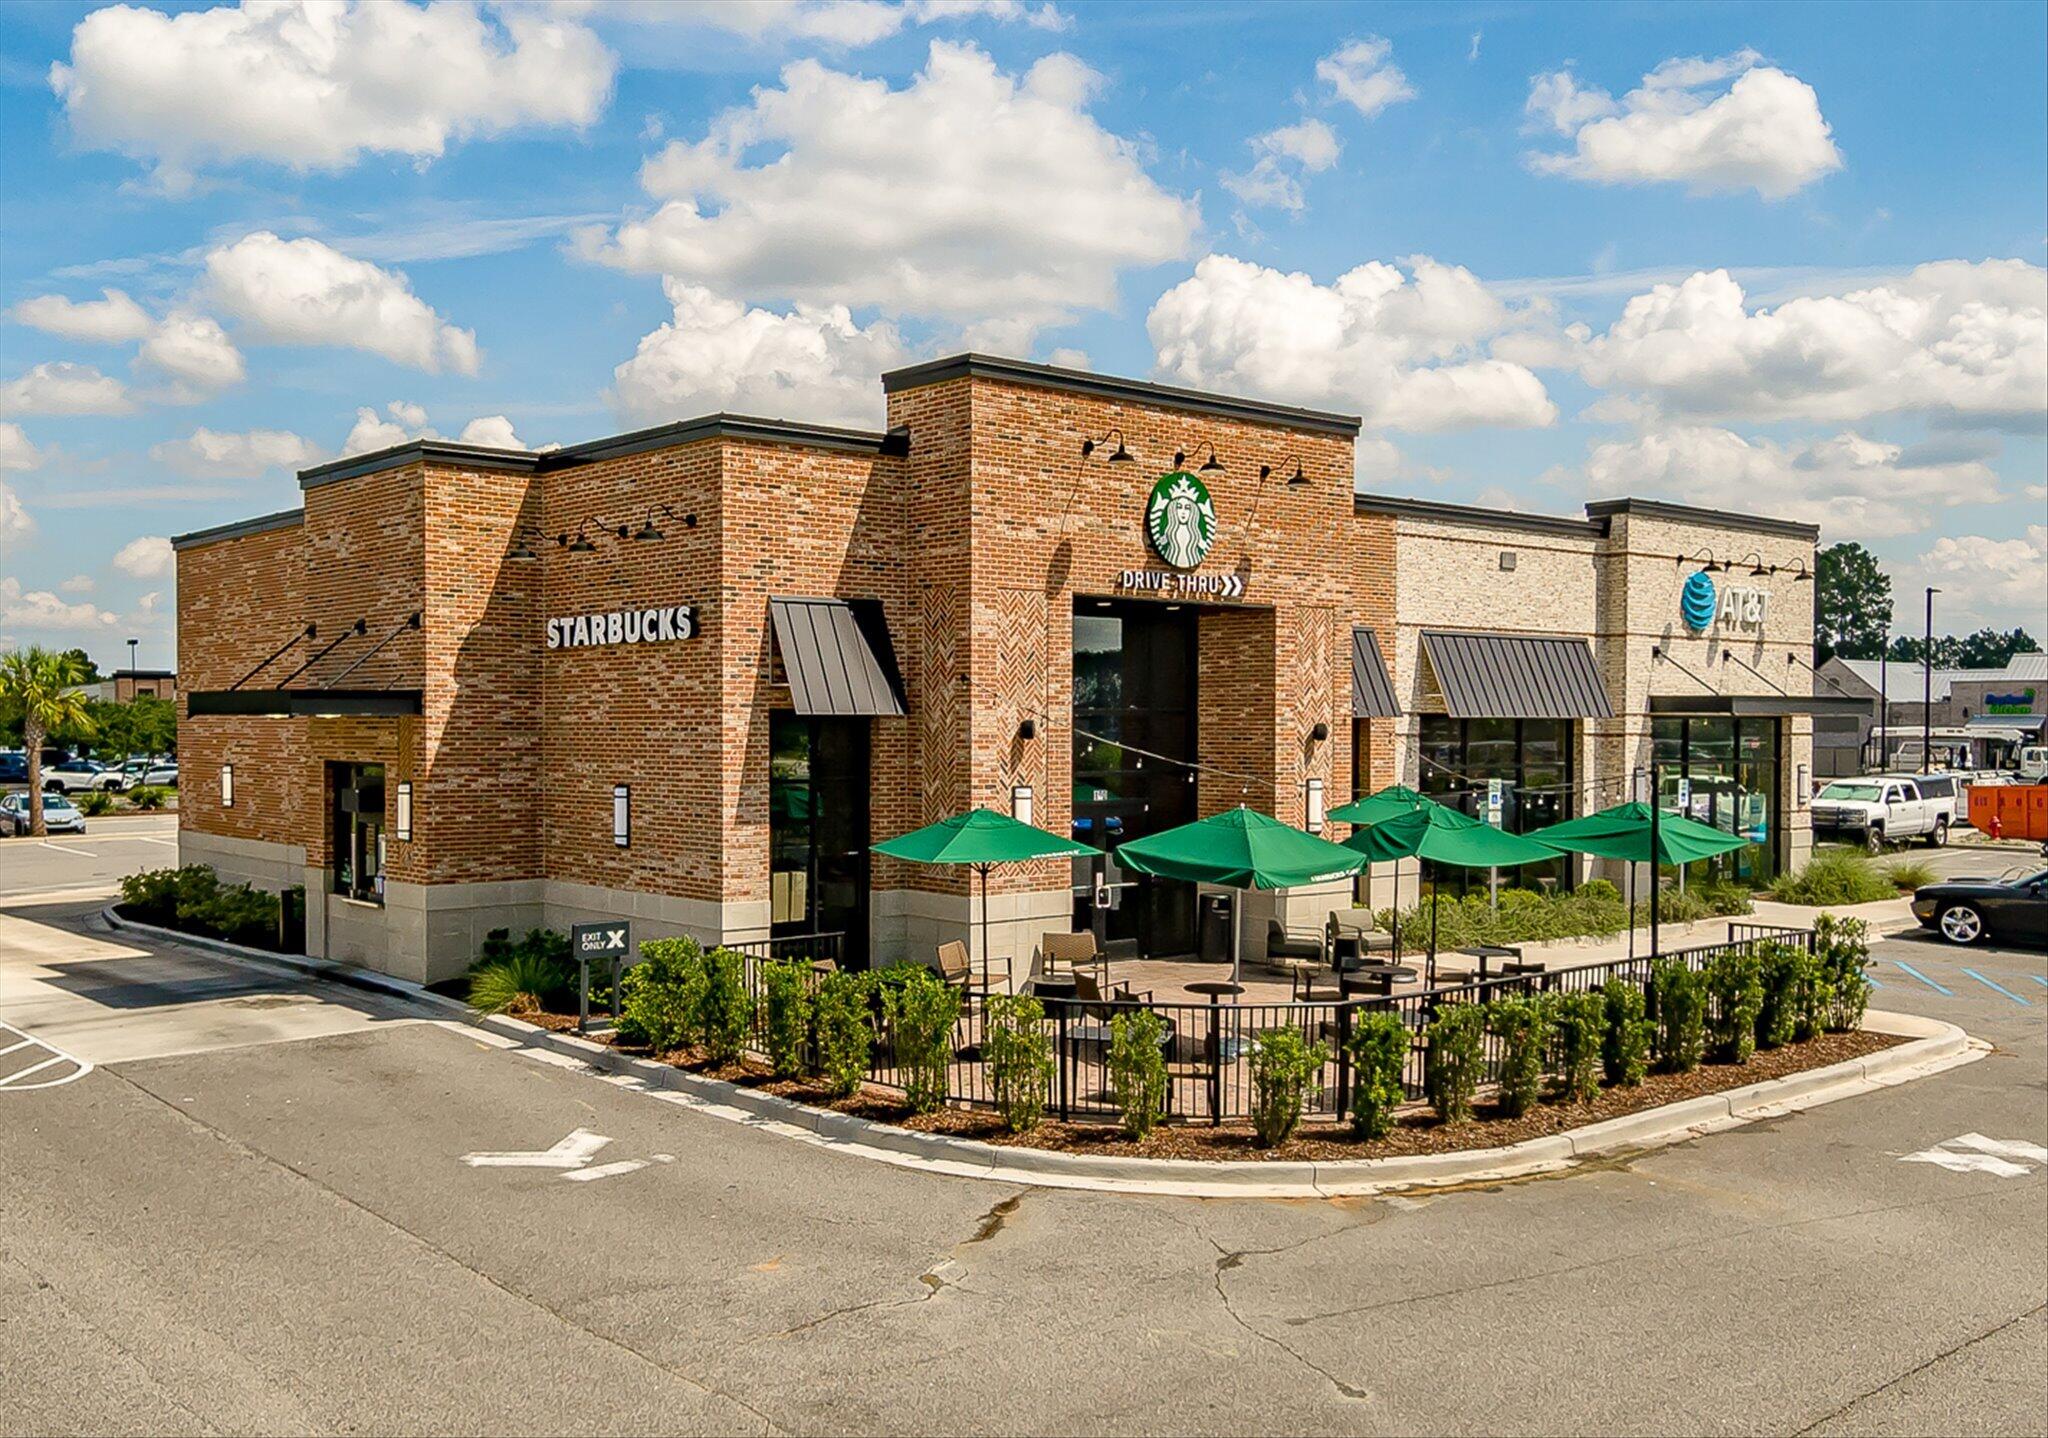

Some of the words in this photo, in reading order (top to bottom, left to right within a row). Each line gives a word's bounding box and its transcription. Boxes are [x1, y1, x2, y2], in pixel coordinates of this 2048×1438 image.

[1123, 571, 1171, 590] DRIVE
[1177, 574, 1219, 593] THRU
[1720, 586, 1772, 623] AT&T
[547, 605, 691, 648] STARBUCKS
[582, 941, 605, 951] ONLY
